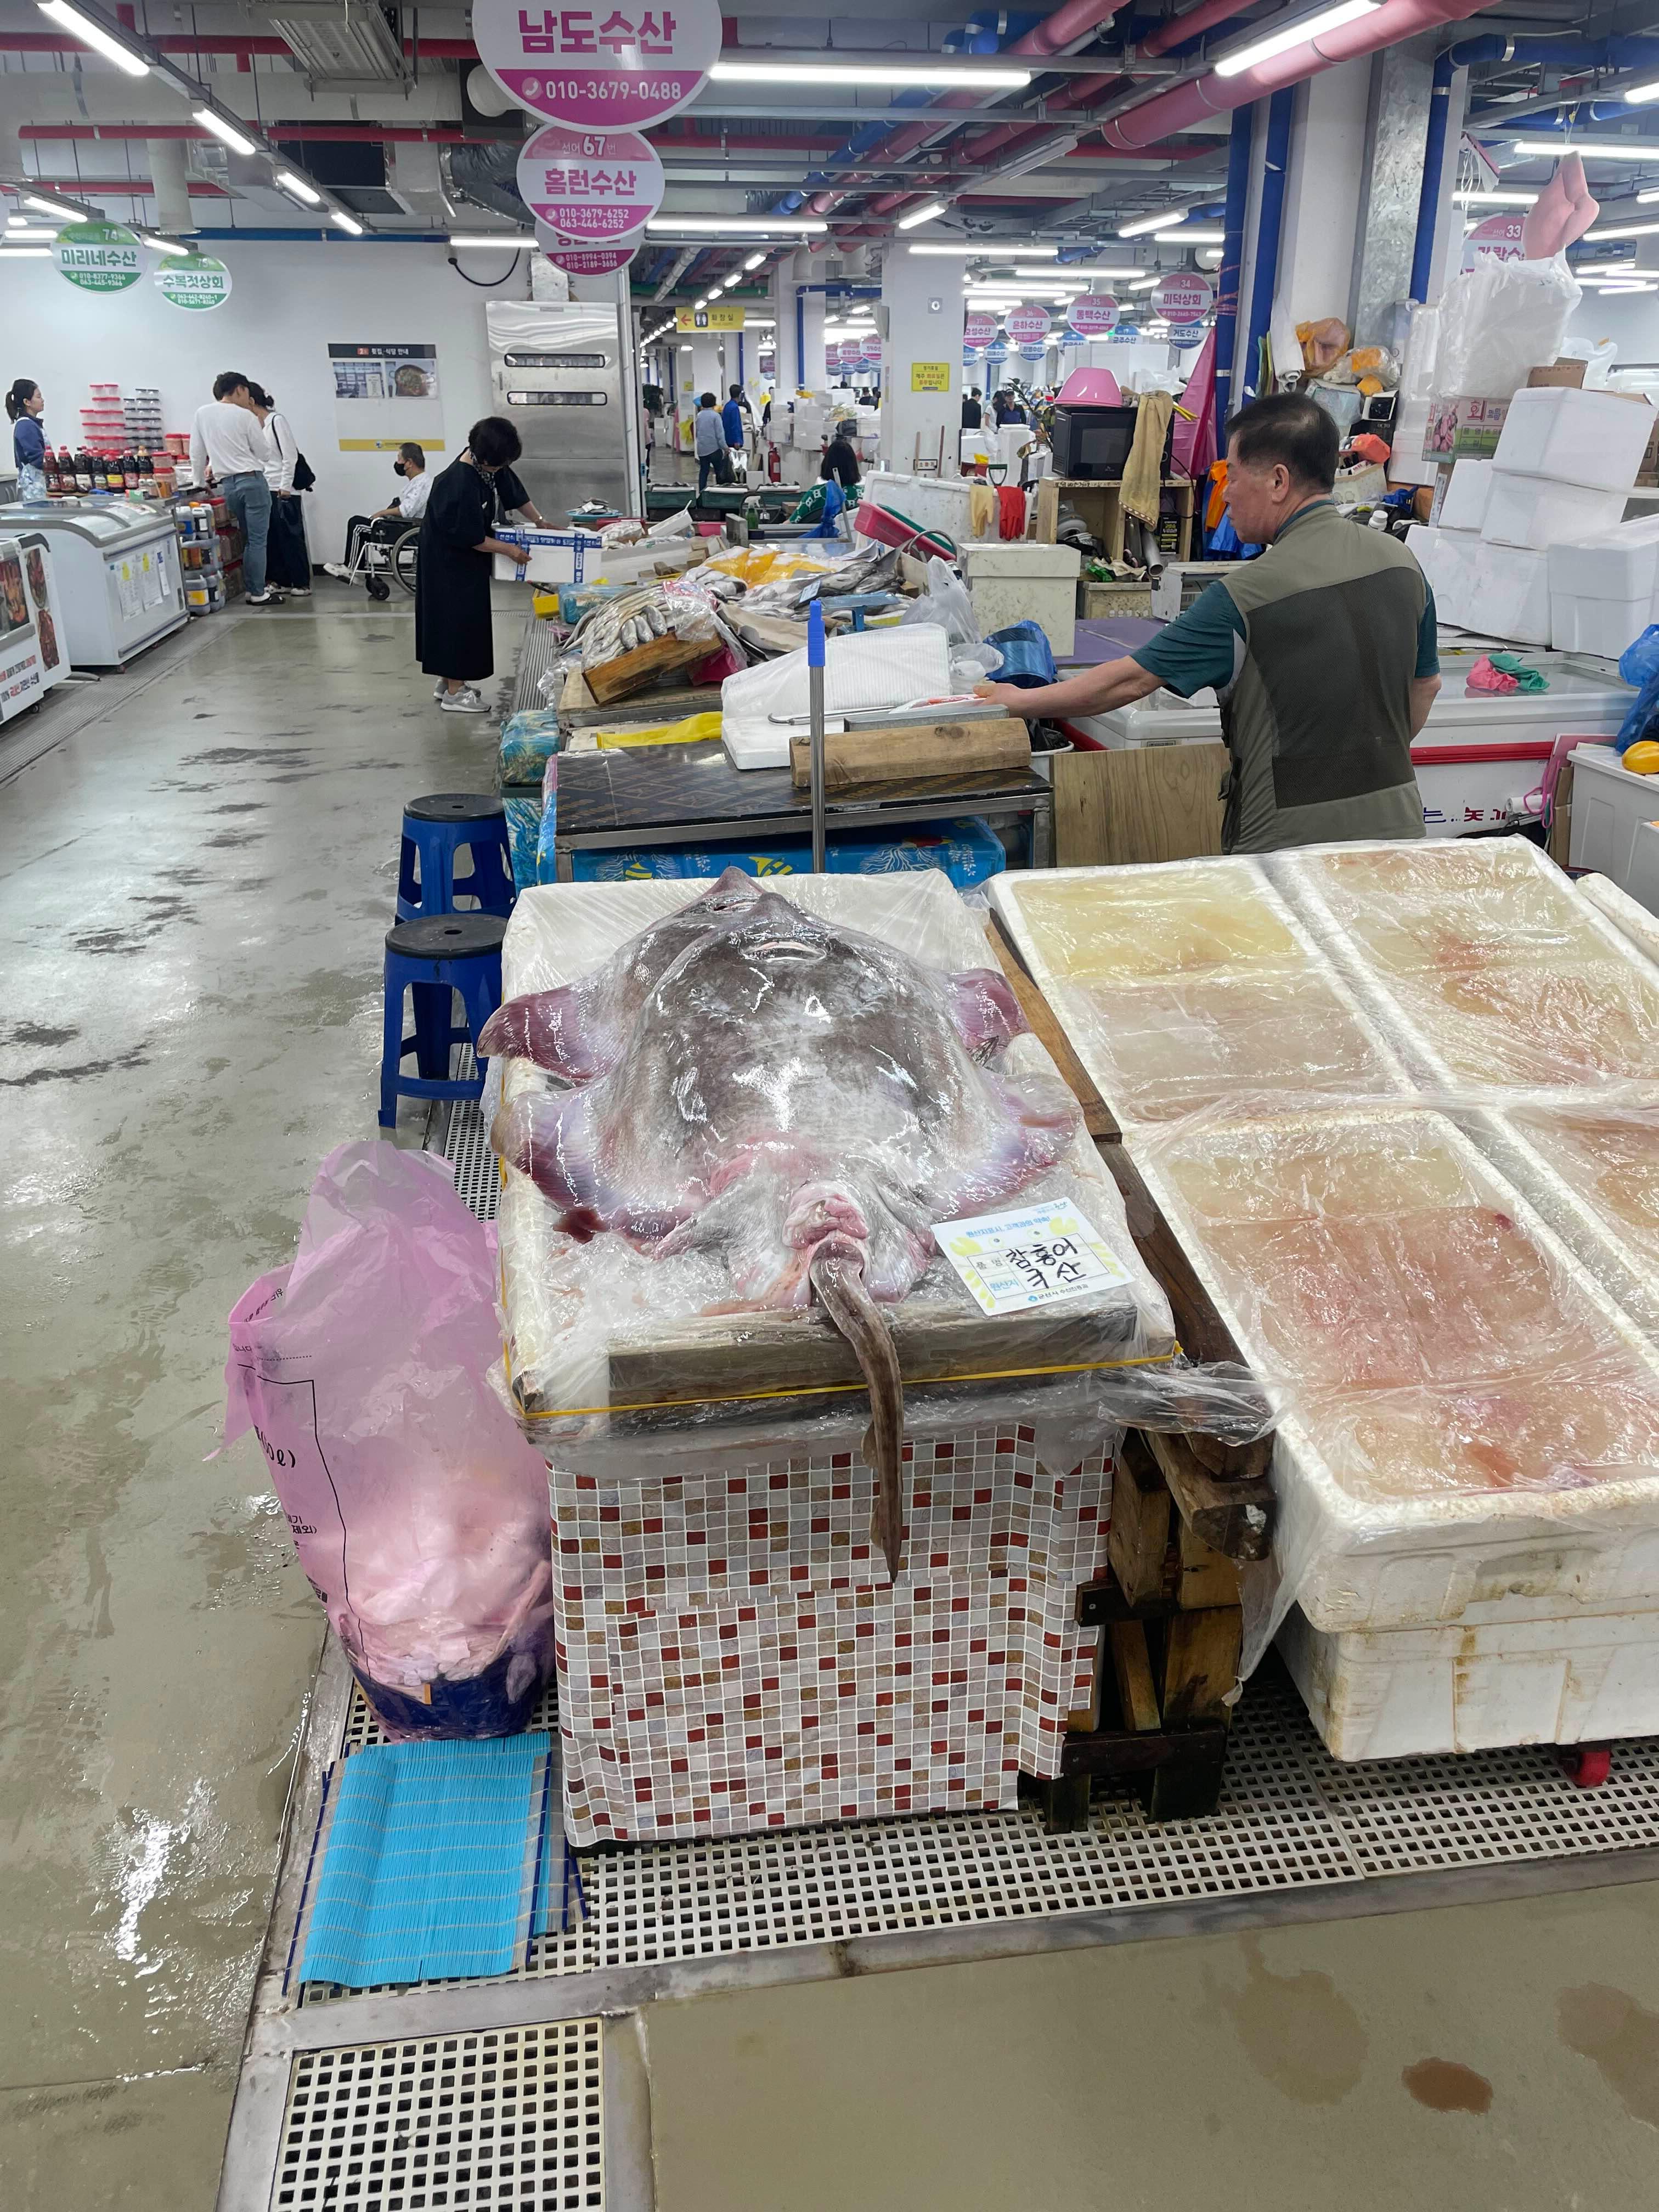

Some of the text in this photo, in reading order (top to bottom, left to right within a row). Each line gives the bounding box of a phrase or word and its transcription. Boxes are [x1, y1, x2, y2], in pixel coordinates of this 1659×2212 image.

[518, 10, 676, 54] 남도수산
[546, 81, 681, 100] 010-3679-0488
[562, 142, 580, 154] 선어
[545, 168, 636, 196] 홈런수산
[560, 208, 629, 219] 010-3679-6252
[560, 218, 624, 229] 063-446-6252
[103, 228, 119, 241] 74
[1506, 224, 1521, 238] 33
[61, 250, 137, 267] 미리네수산
[1180, 279, 1192, 289] 34
[1163, 294, 1201, 305] 미덕상회
[1076, 309, 1111, 320] 동백수산
[1013, 320, 1043, 330] 은하수산
[1006, 1237, 1078, 1269] 참홍어
[990, 1278, 1020, 1291] 원산지
